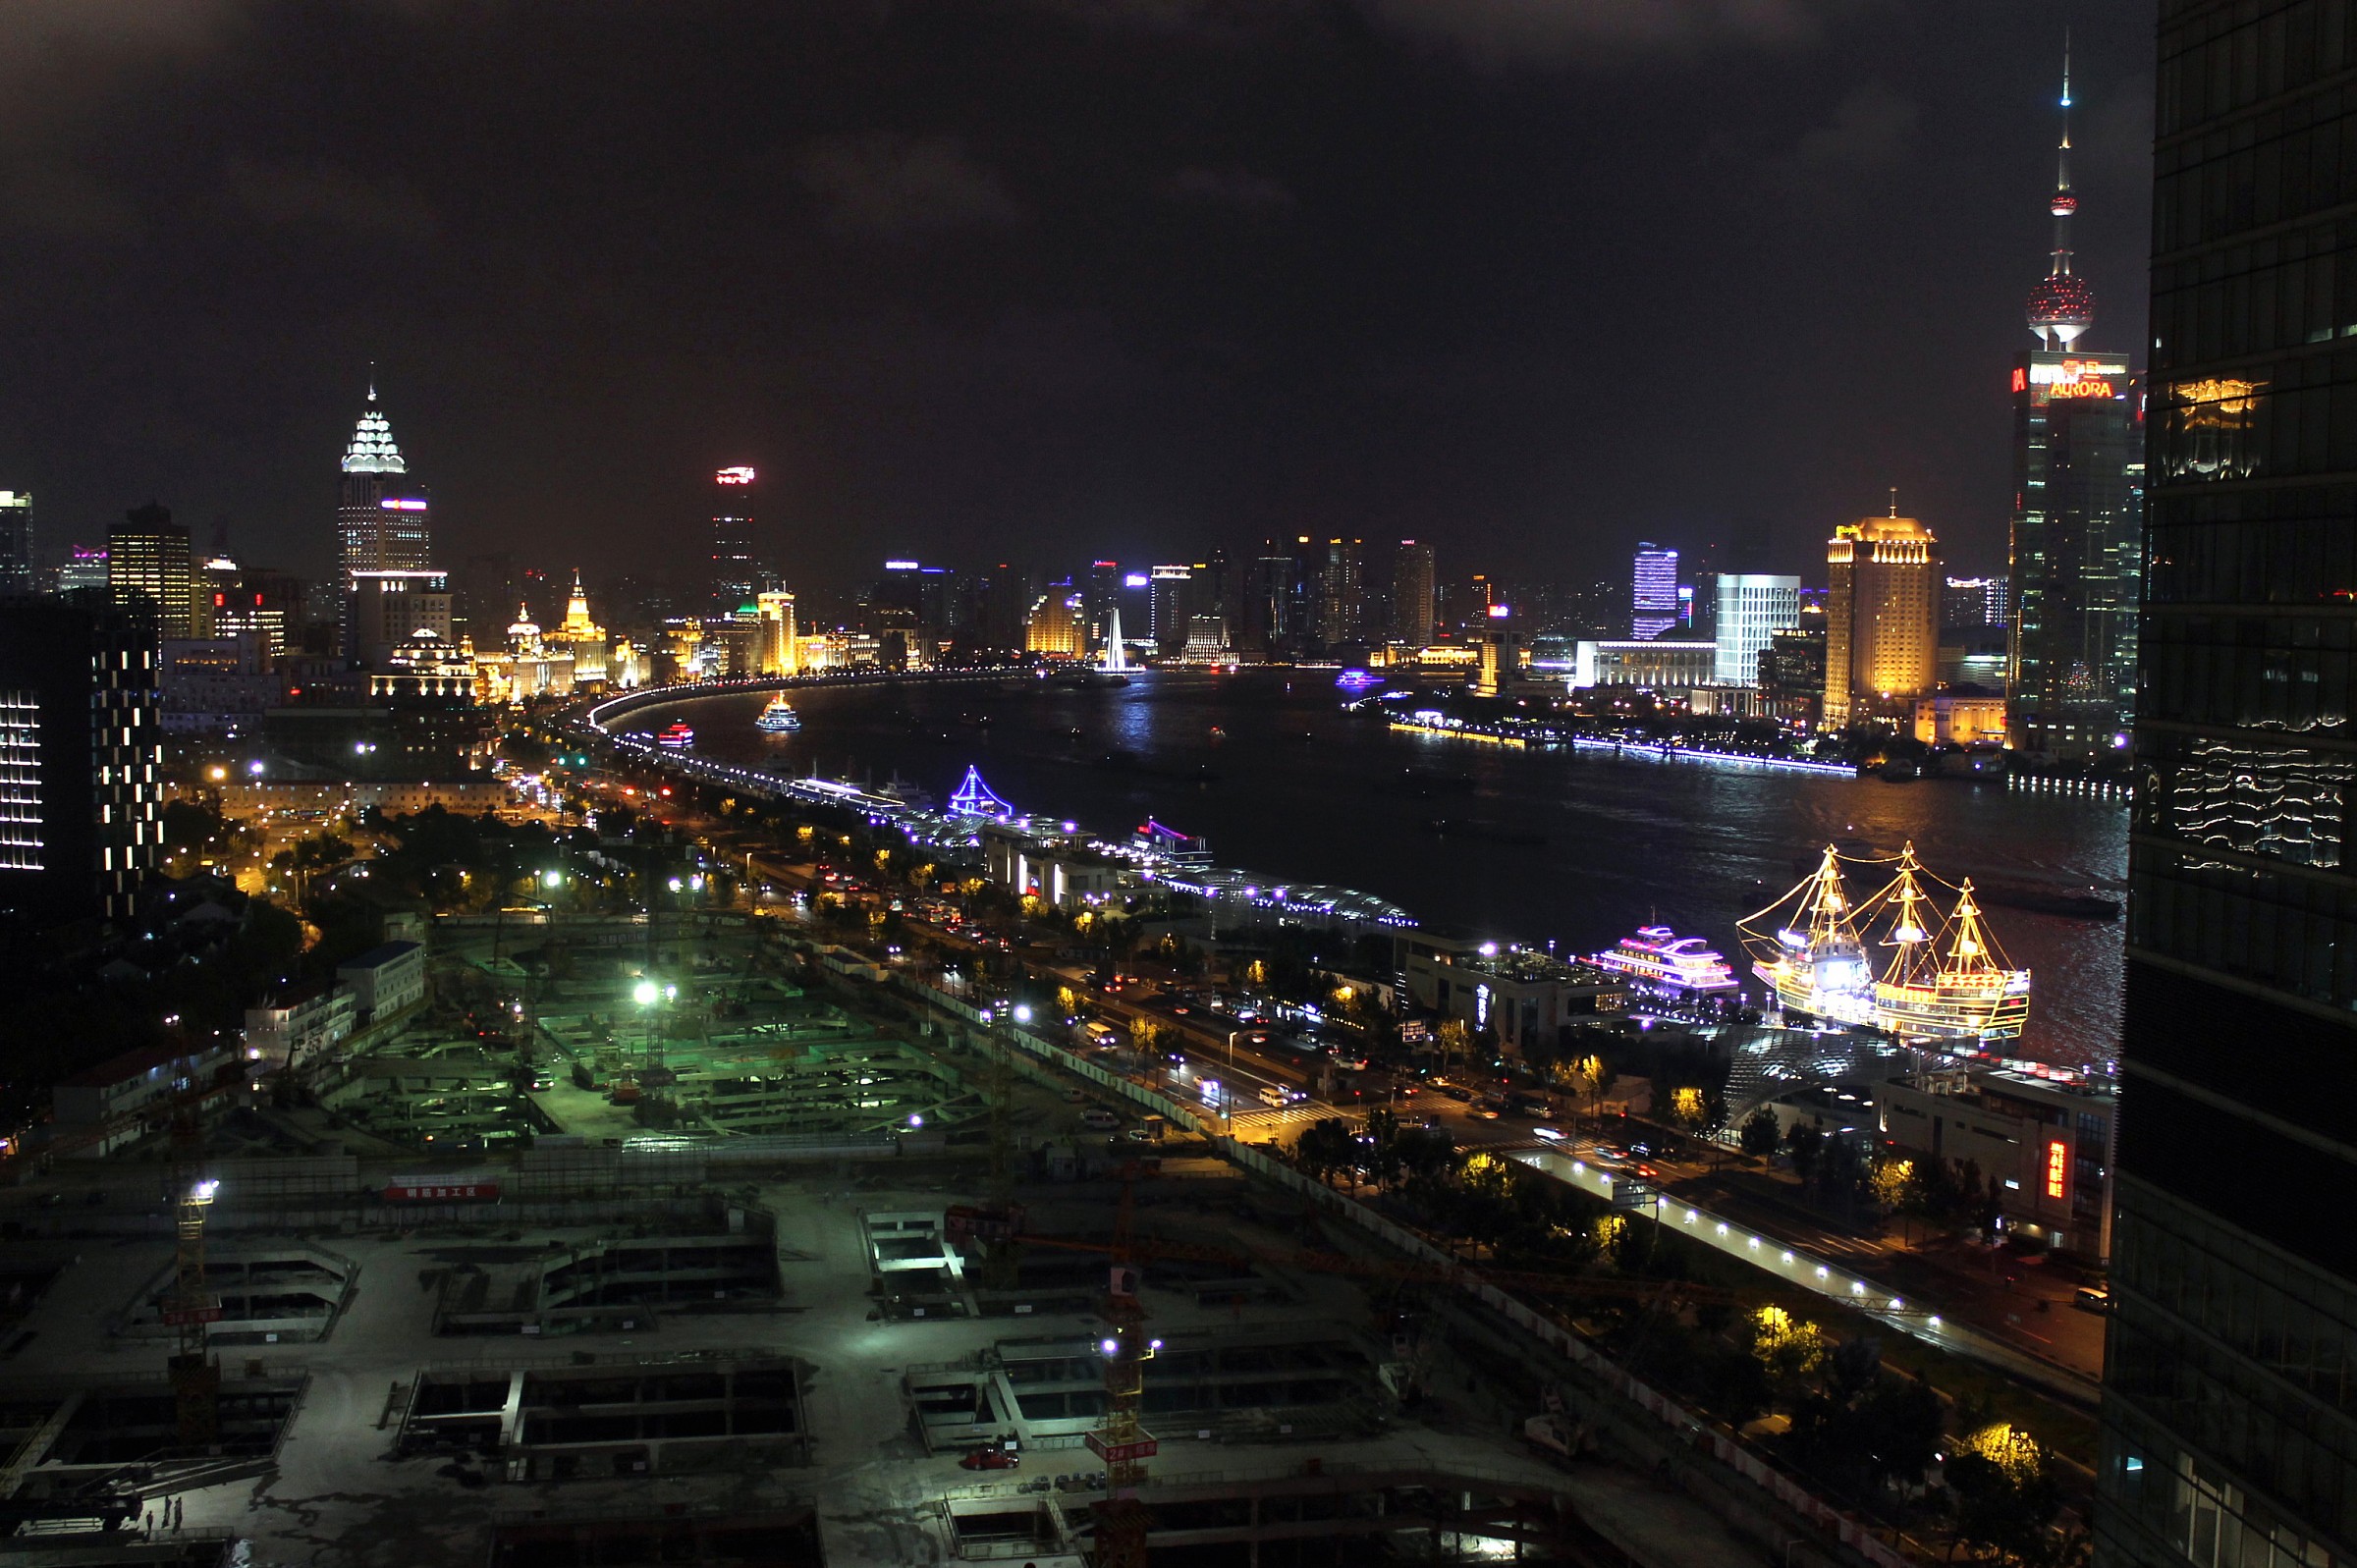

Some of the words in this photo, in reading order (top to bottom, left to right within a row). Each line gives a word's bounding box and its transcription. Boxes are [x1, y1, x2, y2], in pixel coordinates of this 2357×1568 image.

[2049, 381, 2113, 397] AURORA
[407, 1187, 476, 1198] 钢筋加工区
